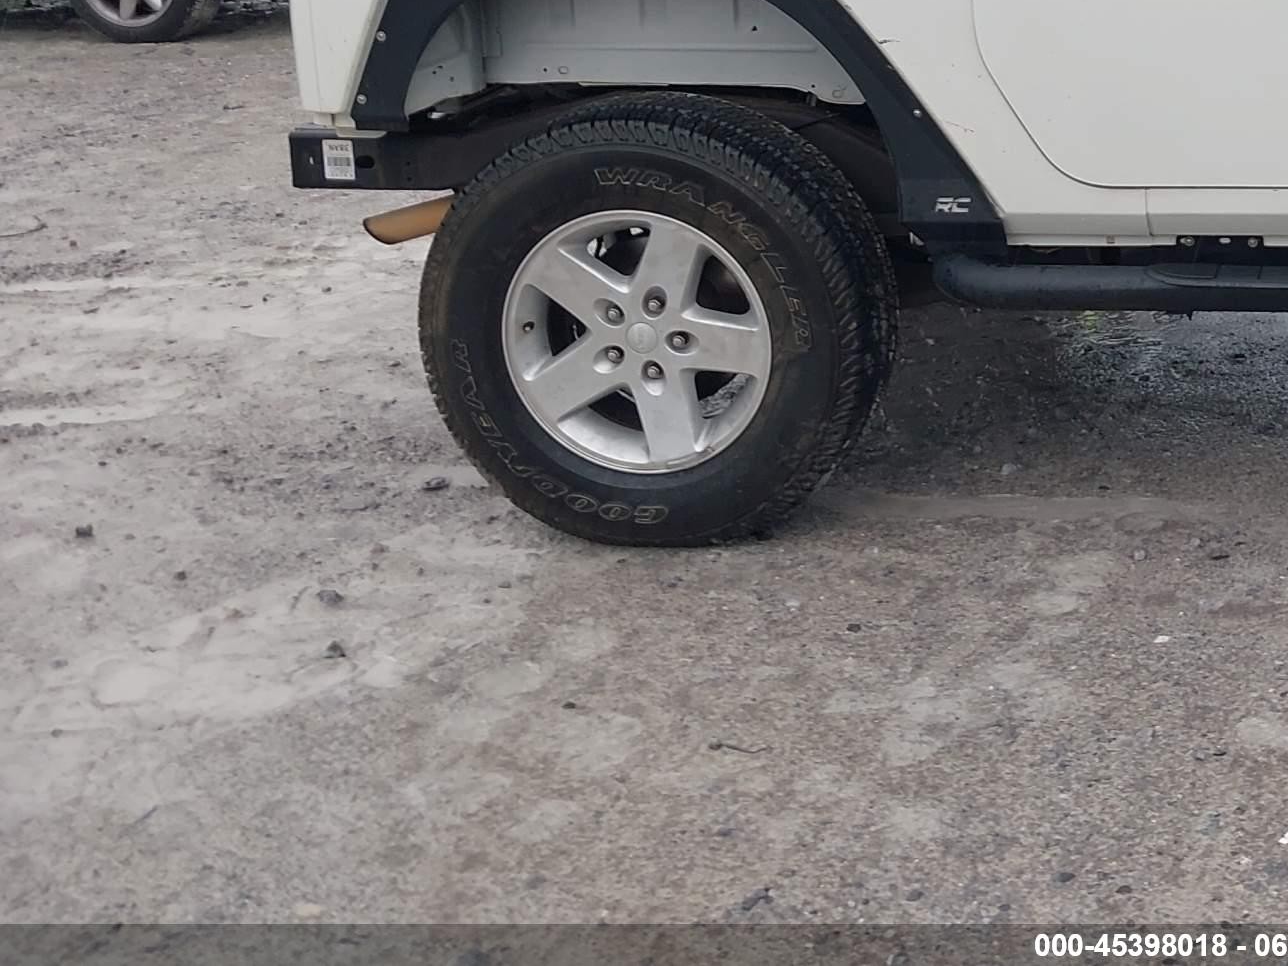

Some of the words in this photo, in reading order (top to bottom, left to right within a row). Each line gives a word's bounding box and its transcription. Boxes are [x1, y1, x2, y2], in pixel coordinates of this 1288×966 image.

[593, 166, 814, 352] WRANGLER
[935, 197, 972, 213] RC
[451, 336, 670, 525] GOODYEAR
